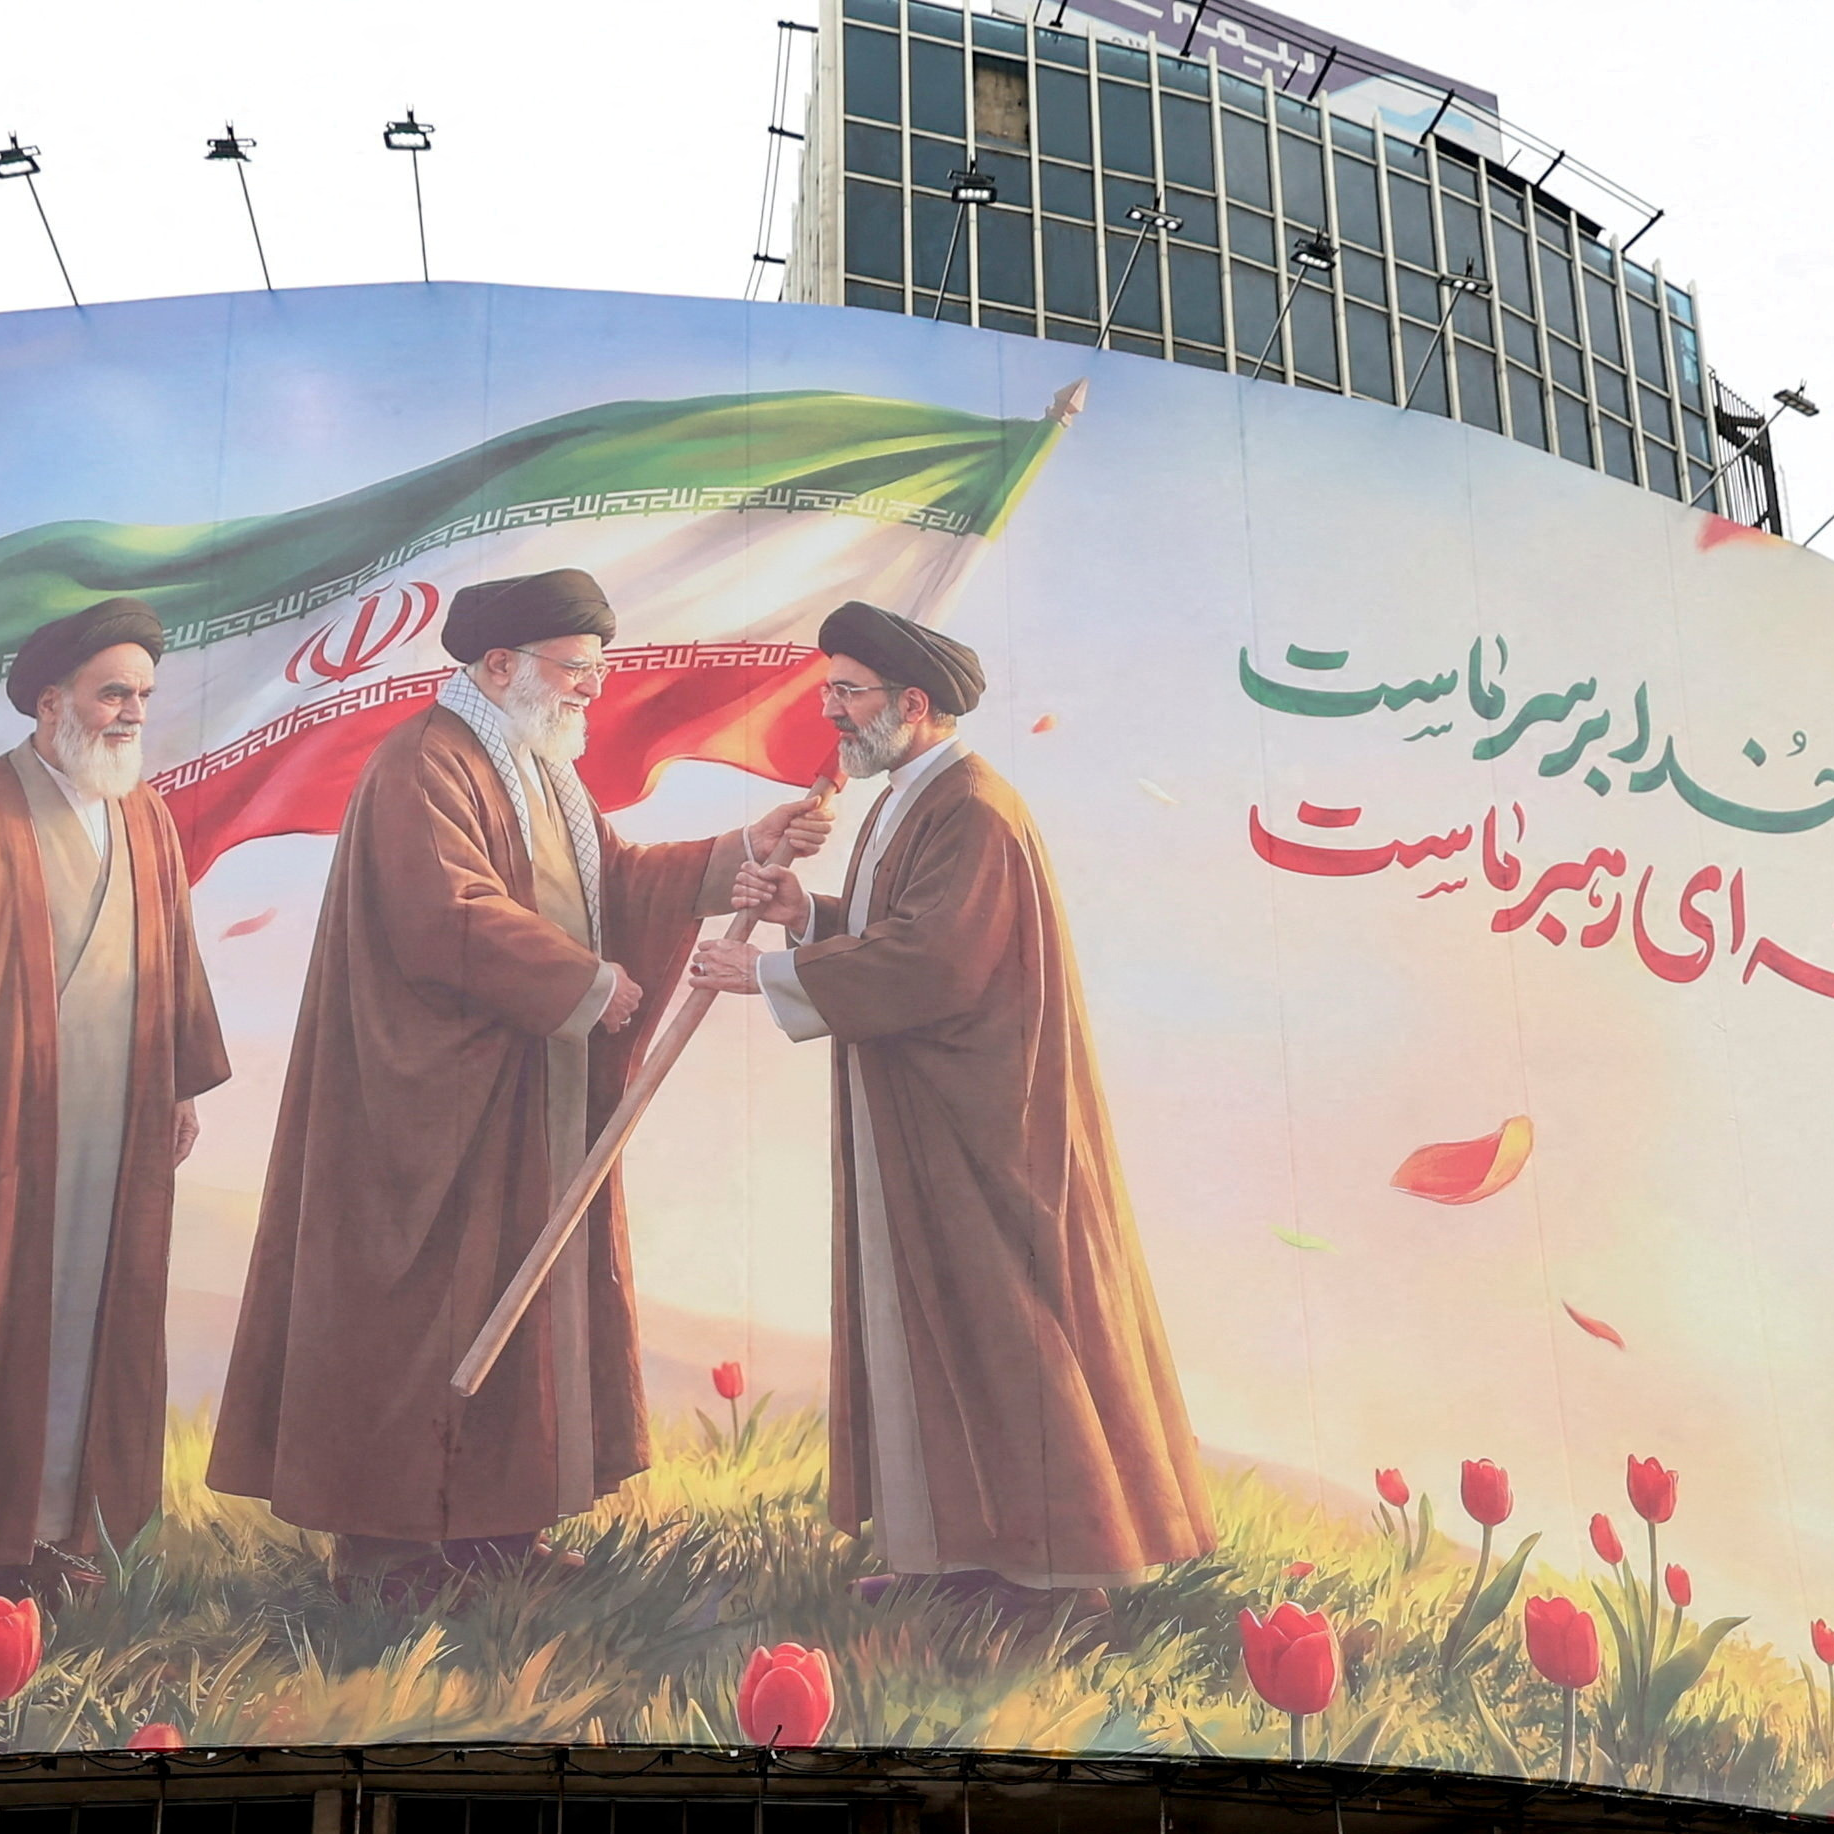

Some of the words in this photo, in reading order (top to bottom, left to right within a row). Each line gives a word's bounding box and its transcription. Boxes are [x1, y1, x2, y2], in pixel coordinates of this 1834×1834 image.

[1238, 633, 1509, 742] ماست
[1472, 676, 1598, 761] سر
[1537, 707, 1612, 797] بر
[1248, 800, 1526, 900] ماست
[1490, 846, 1627, 949] رهبر
